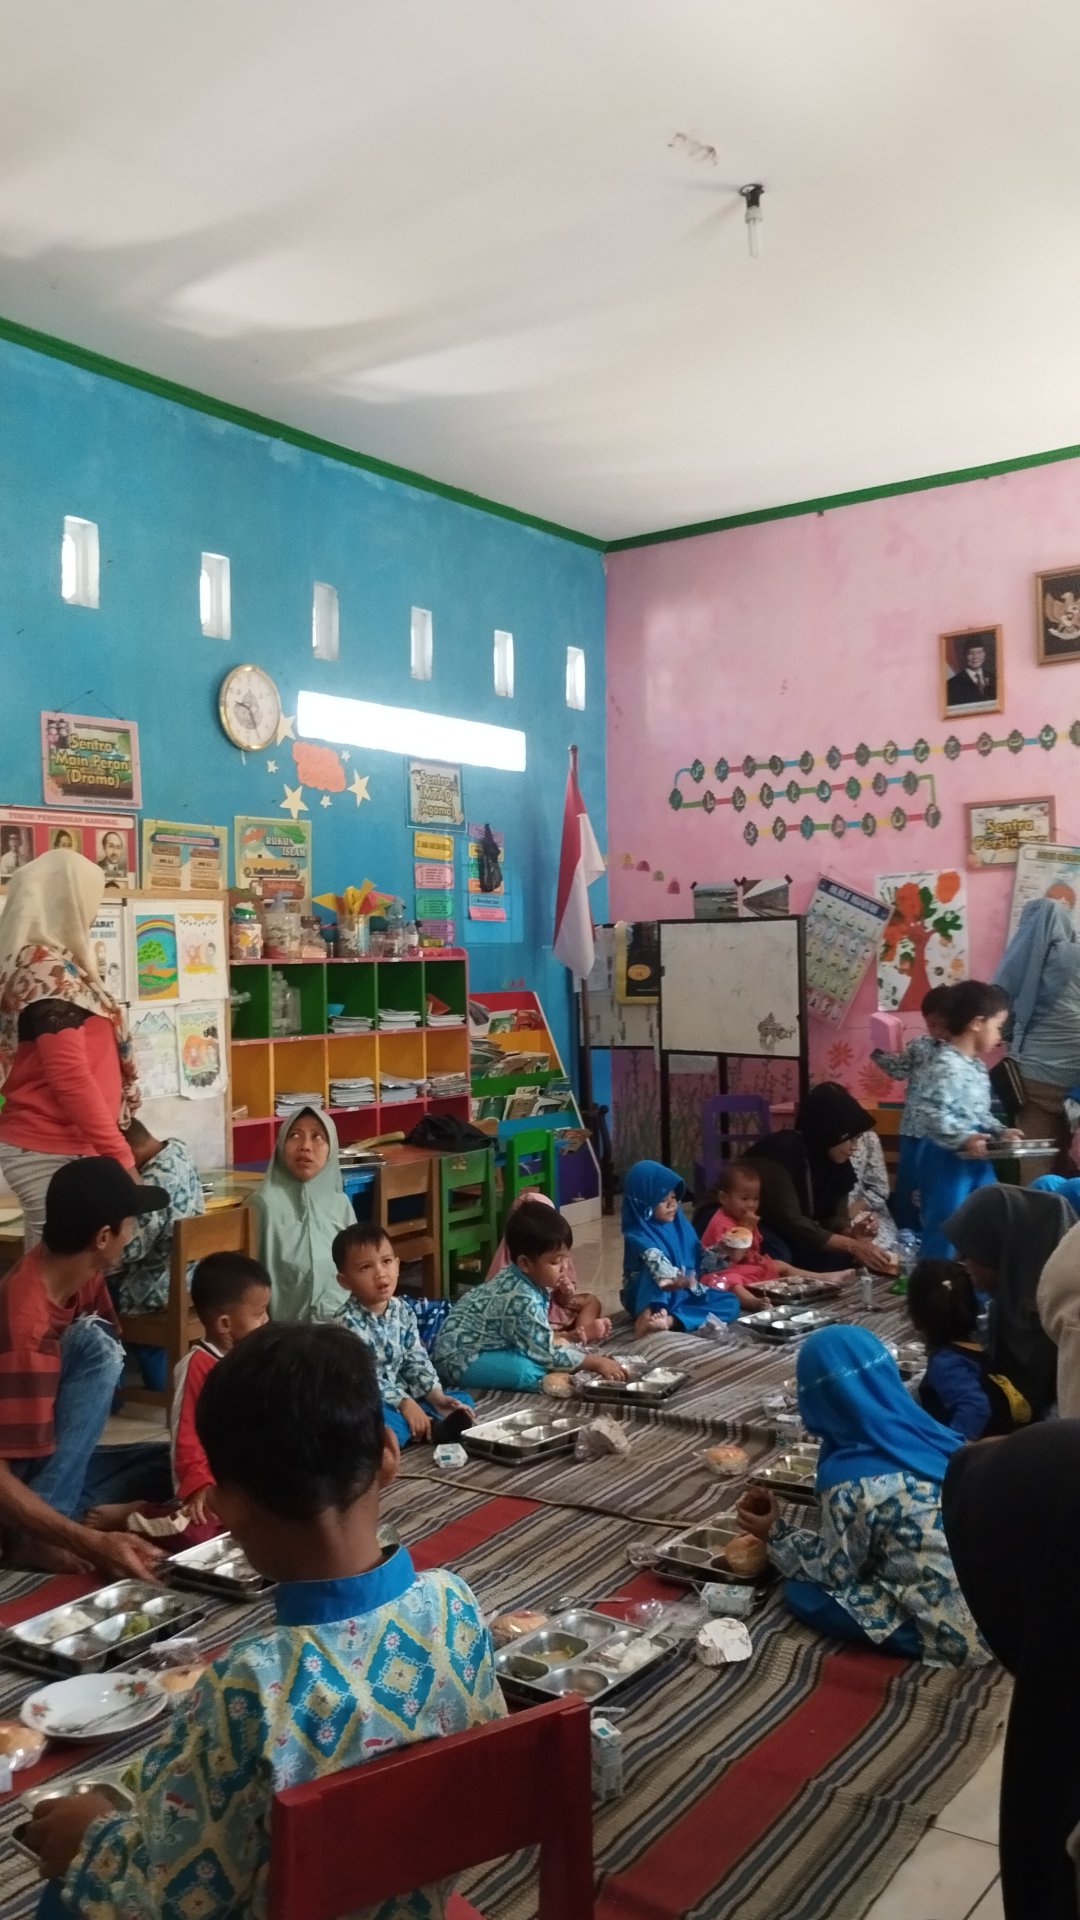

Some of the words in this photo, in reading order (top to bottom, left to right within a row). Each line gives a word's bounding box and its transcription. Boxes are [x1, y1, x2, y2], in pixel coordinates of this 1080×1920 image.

[69, 734, 113, 752] Sentra
[56, 752, 89, 766] Main
[93, 754, 129, 770] Peran
[66, 769, 120, 788] (Drama)
[420, 769, 451, 787] Sentra
[420, 785, 453, 805] IMTAQ
[986, 818, 1034, 833] Sentra
